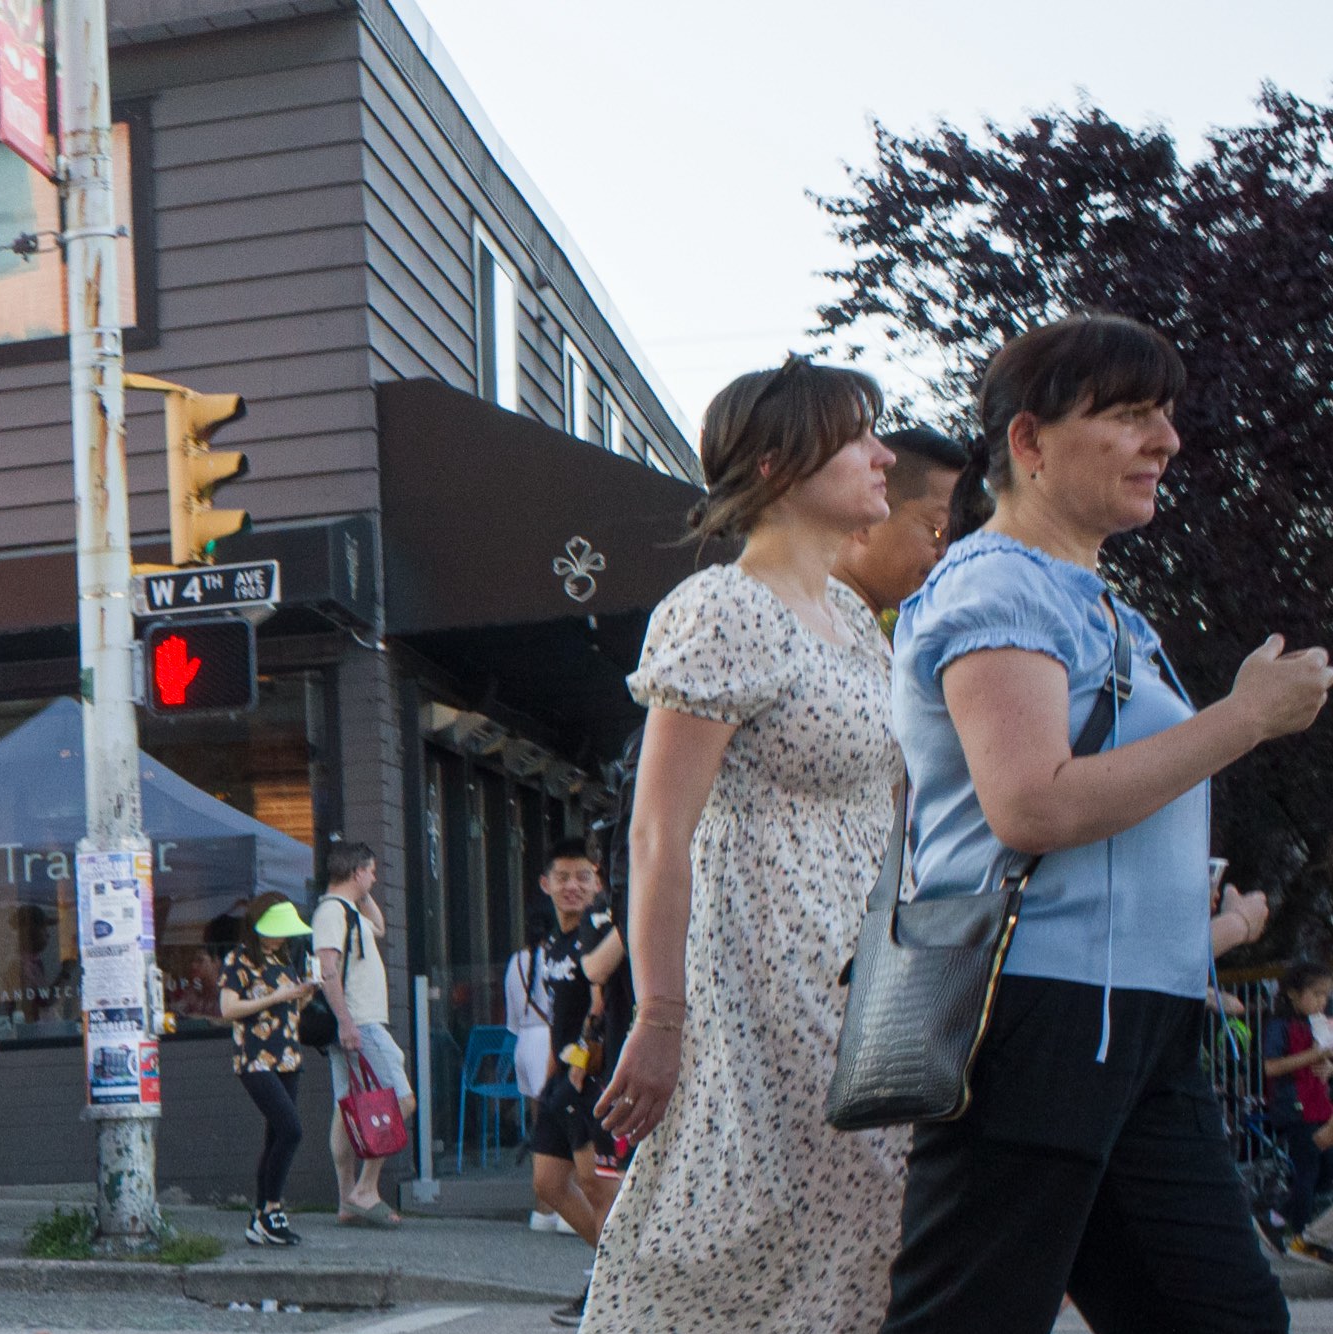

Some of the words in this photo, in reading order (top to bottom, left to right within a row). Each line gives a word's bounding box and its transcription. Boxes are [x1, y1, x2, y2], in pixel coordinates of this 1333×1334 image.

[151, 579, 175, 607] W
[182, 573, 223, 603] 4TH
[234, 569, 265, 587] AVE
